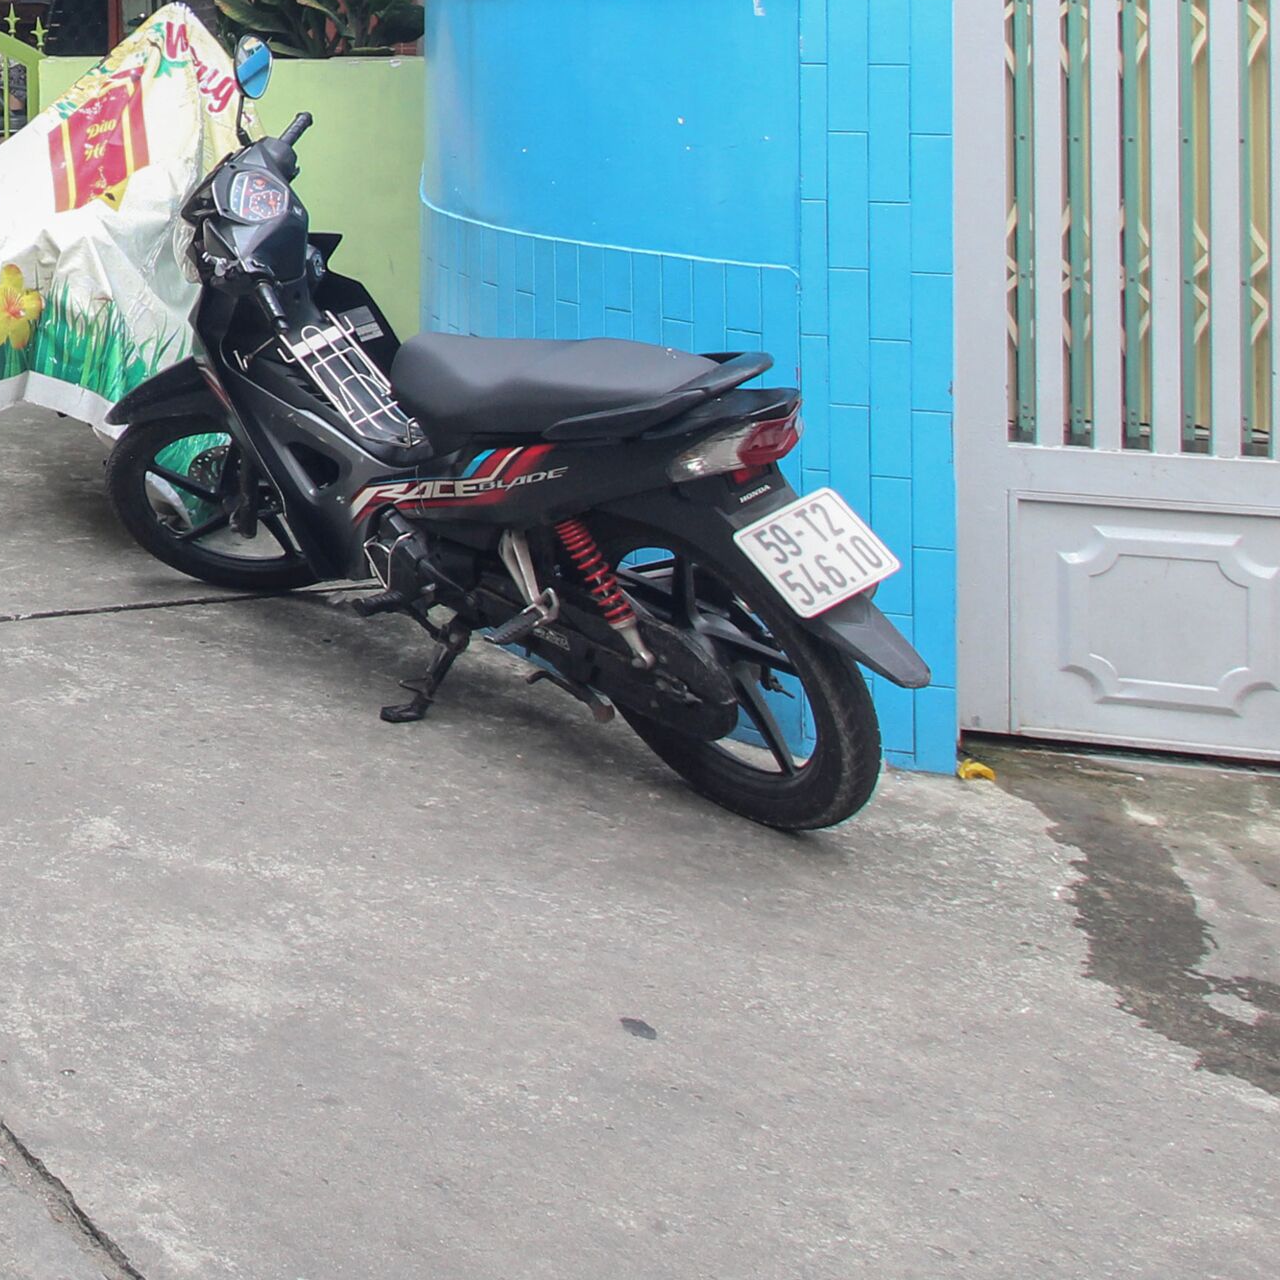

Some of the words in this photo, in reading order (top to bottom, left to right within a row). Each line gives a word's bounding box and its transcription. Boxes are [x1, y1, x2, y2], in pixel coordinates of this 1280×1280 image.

[740, 484, 771, 503] HONDA
[753, 503, 845, 564] 59-T2
[779, 535, 883, 606] 546.10
